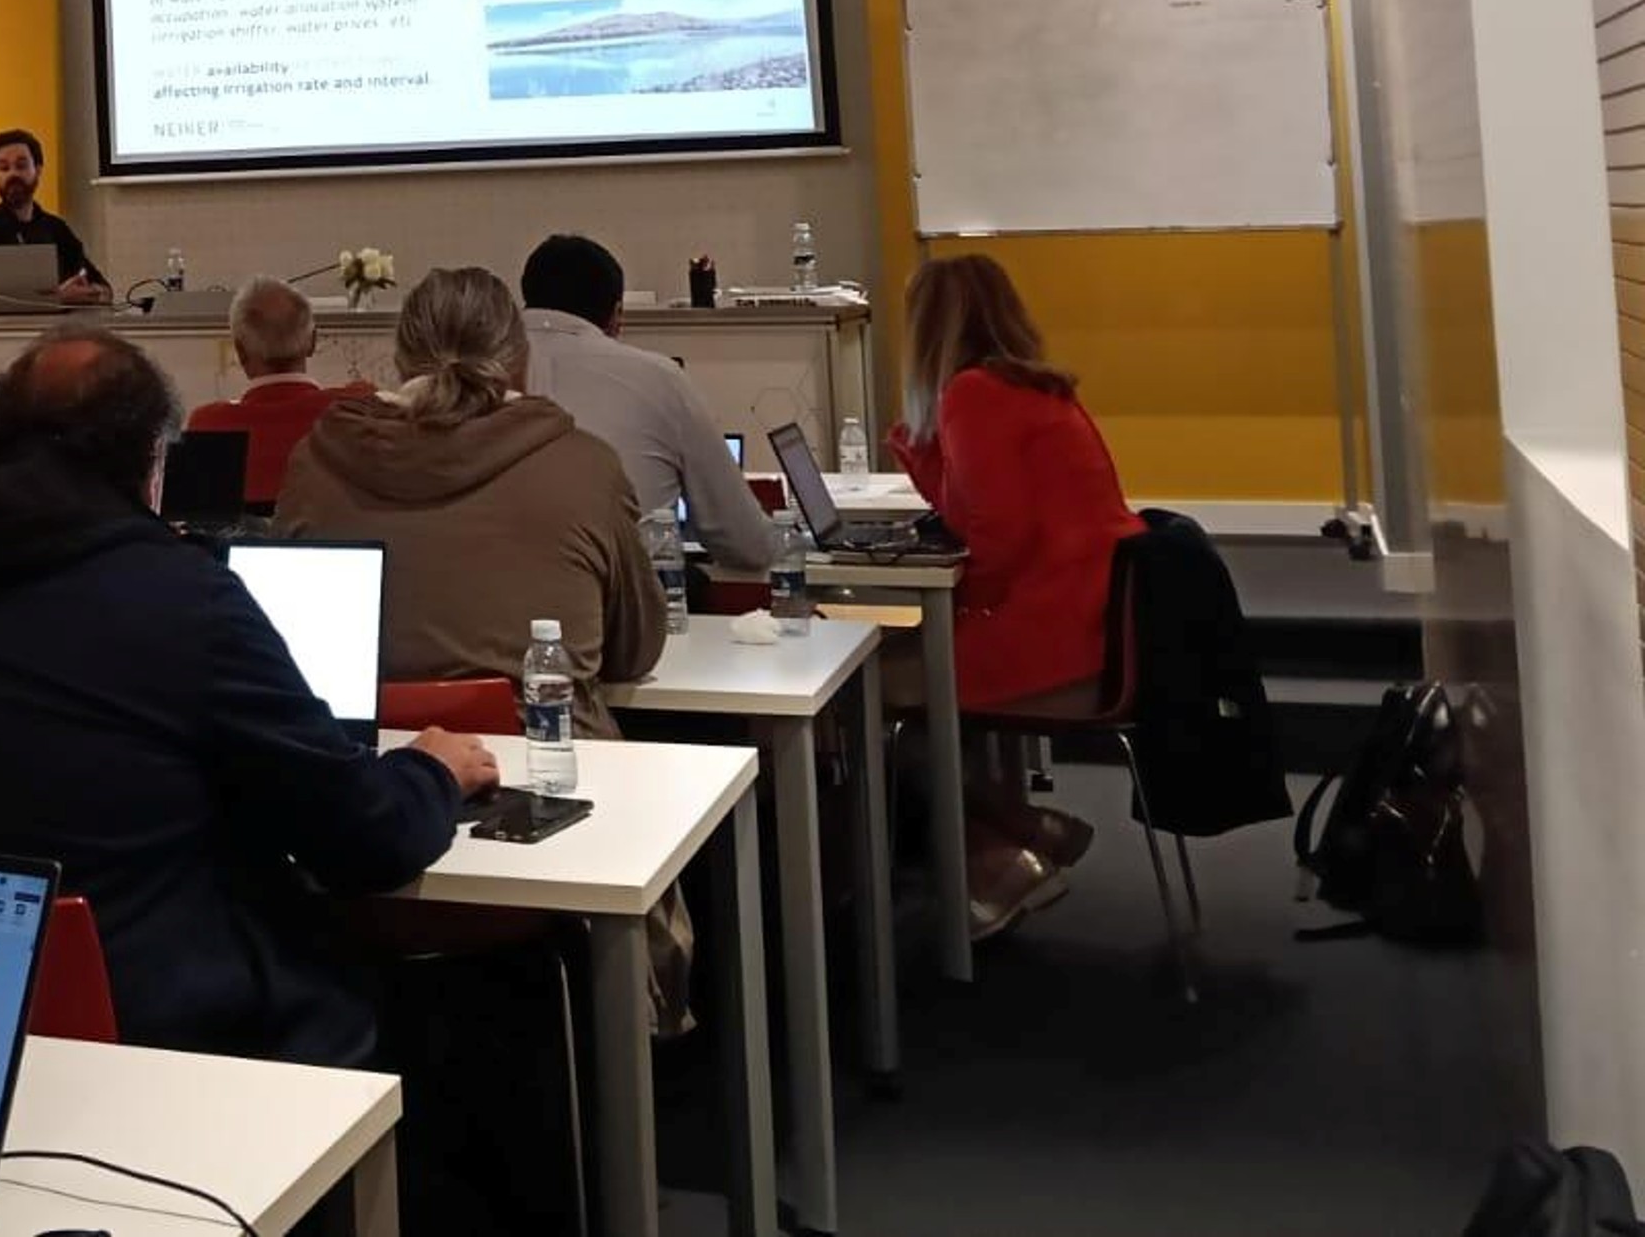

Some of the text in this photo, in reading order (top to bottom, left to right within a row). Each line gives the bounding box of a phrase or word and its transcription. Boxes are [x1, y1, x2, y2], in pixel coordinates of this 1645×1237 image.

[206, 60, 289, 78] availability
[153, 71, 430, 100] affecting irrigation rate and interval
